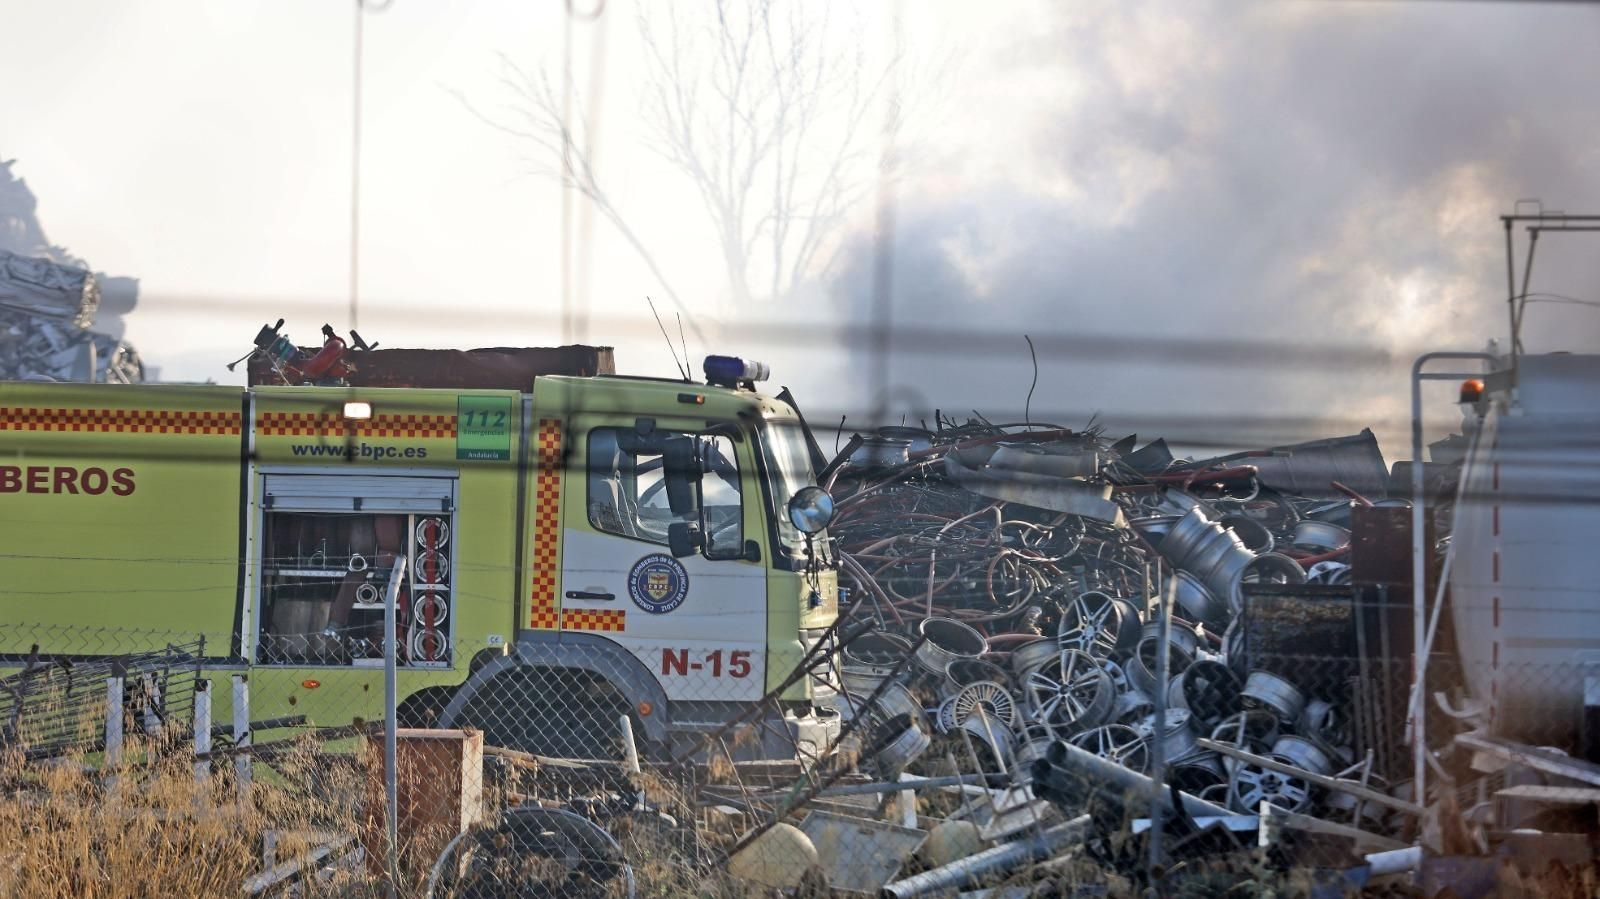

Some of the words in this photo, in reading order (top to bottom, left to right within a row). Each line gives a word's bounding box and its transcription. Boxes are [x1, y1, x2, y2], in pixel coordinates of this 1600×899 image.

[464, 410, 505, 427] 112
[292, 443, 427, 460] www.cbpc.es
[0, 465, 136, 496] BEROS
[632, 556, 658, 576] BOMBEROS
[672, 563, 686, 592] PROVINCIA
[632, 587, 654, 611] CONSORCIO
[662, 648, 750, 678] N-15
